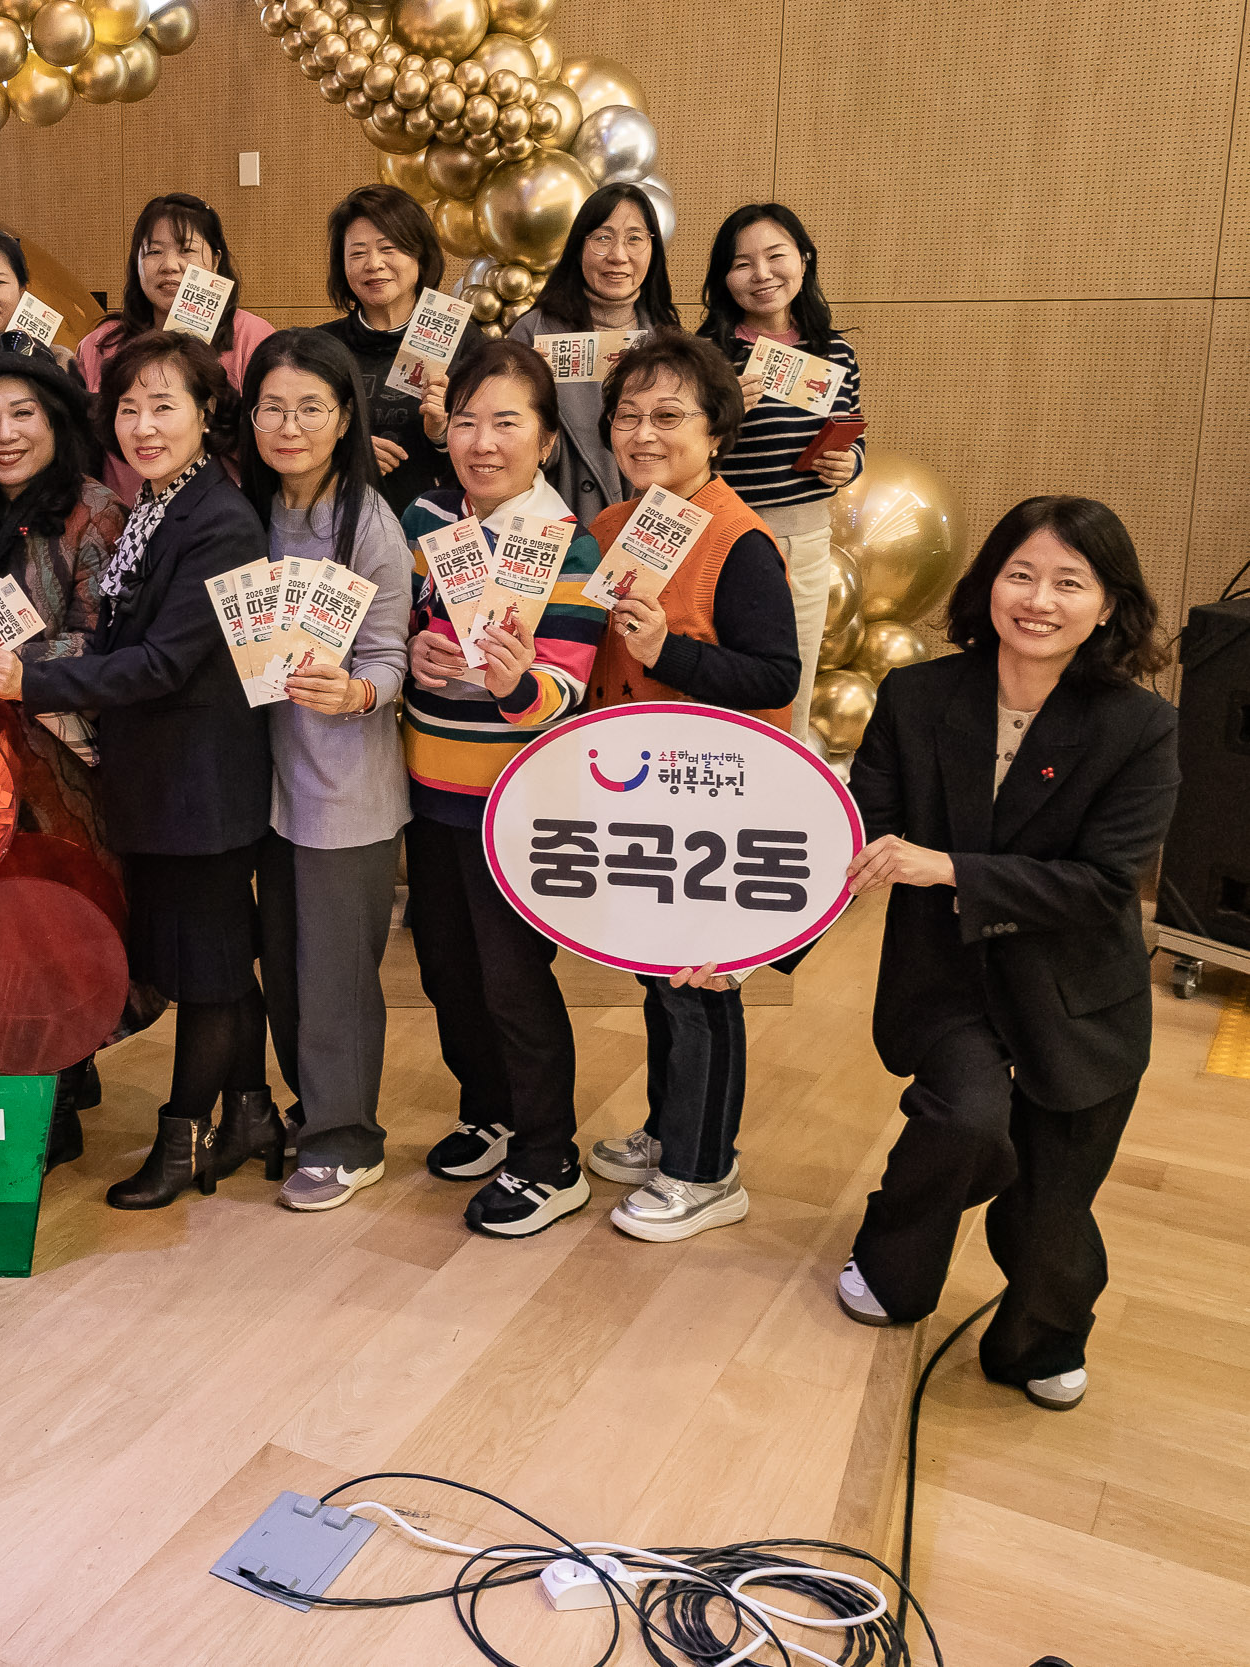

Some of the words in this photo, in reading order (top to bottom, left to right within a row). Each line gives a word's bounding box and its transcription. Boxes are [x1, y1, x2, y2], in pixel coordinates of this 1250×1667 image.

[187, 283, 200, 292] 2026
[179, 300, 214, 320] 겨울나기
[182, 289, 219, 312] 따뜻한
[422, 307, 437, 317] 2026
[17, 314, 48, 341] 따뜻한
[414, 326, 452, 346] 겨울나기
[417, 314, 457, 338] 따뜻한
[558, 340, 571, 377] 따뜻한
[571, 340, 580, 376] 겨울나기
[763, 350, 785, 389] 따뜻한
[772, 354, 793, 392] 겨울나기
[645, 507, 664, 520] 2026
[508, 534, 528, 545] 2026
[630, 527, 678, 557] 겨울나기
[636, 514, 686, 548] 따뜻한
[434, 552, 450, 563] 2026
[437, 549, 484, 578] 따뜻한
[503, 543, 556, 567] 따뜻한
[443, 565, 488, 589] 겨울나기
[499, 558, 551, 579] 겨울나기
[245, 590, 264, 599] 2026
[288, 580, 305, 588] 2026
[318, 582, 335, 594] 2026
[247, 594, 277, 615] 따뜻
[311, 590, 358, 623] 따뜻한
[306, 604, 351, 634] 겨울나기
[658, 750, 698, 767] 소통하며
[701, 752, 745, 768] 발전하는
[658, 766, 744, 797] 행복광진
[529, 818, 810, 912] 중곡2동
